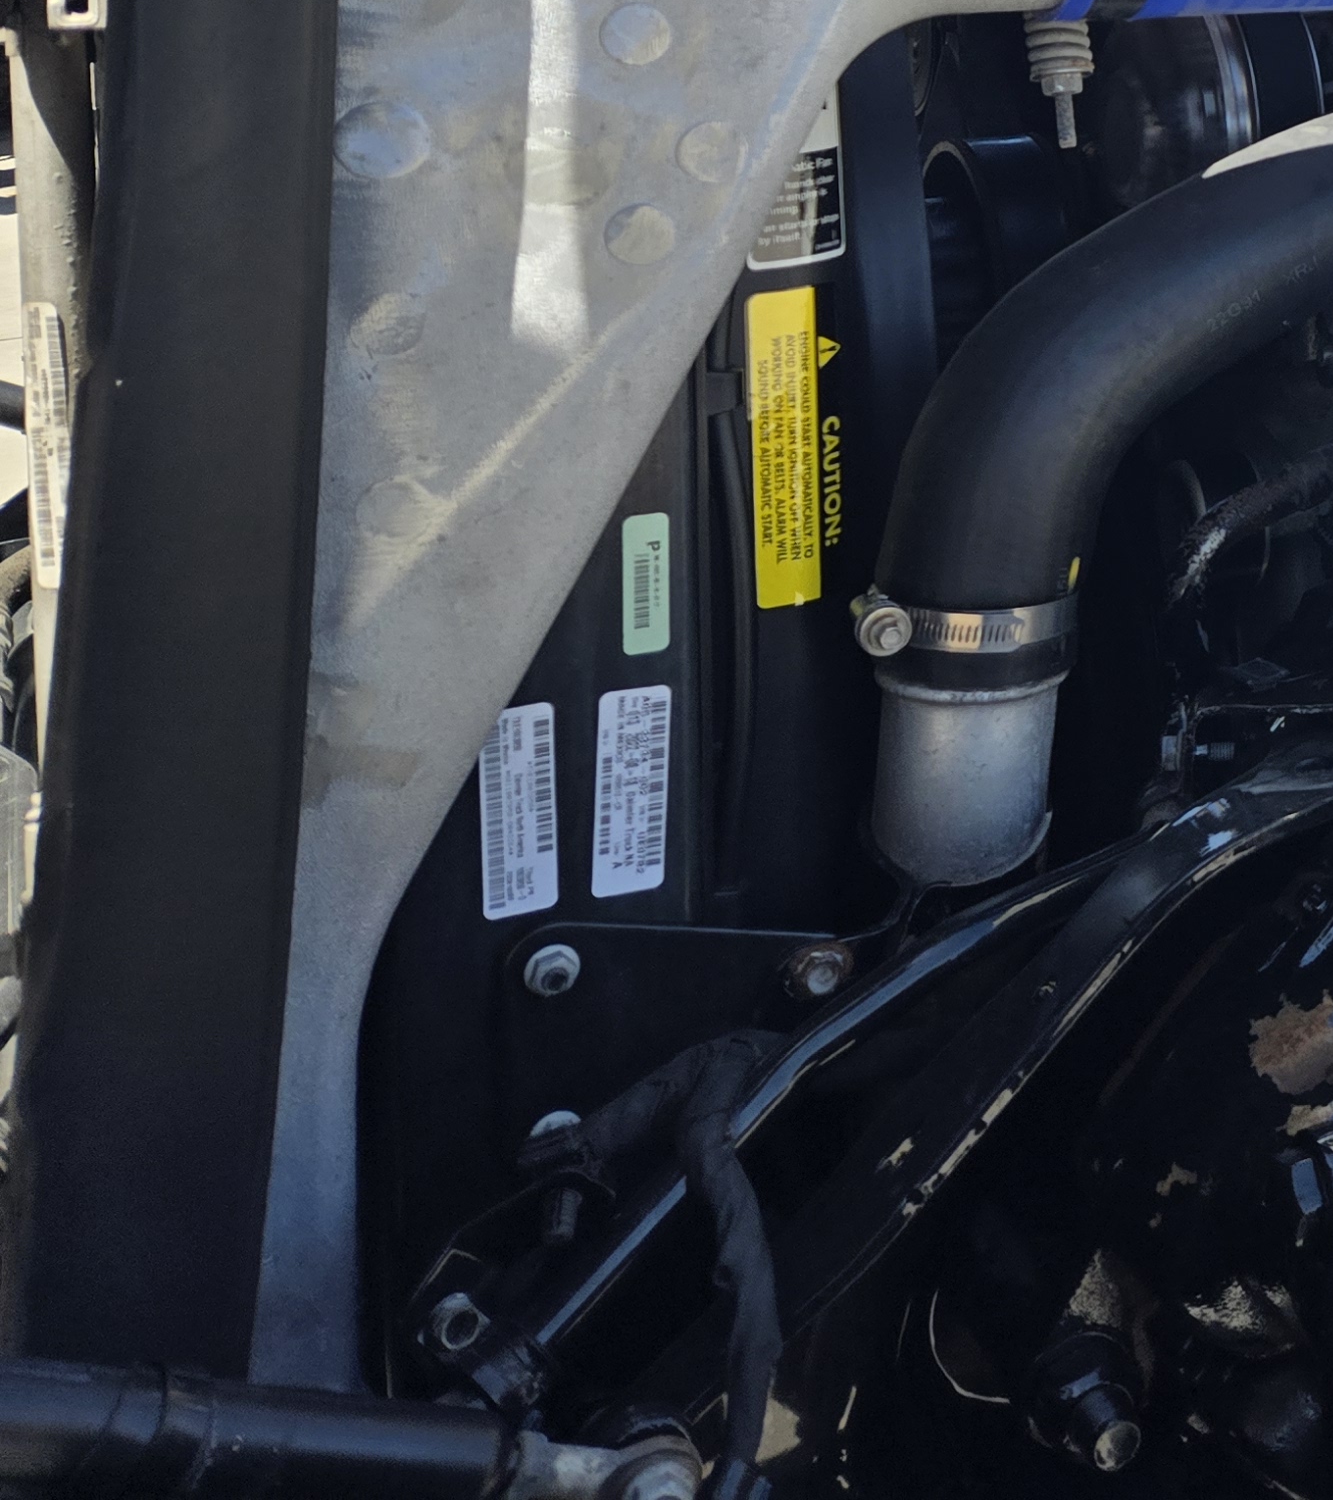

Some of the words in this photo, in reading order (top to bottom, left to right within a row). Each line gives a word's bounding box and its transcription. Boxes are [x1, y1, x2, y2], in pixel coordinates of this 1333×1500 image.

[773, 395, 783, 413] ON
[760, 447, 772, 511] AUTOMATIC
[821, 415, 841, 546] CAUTION:
[775, 498, 786, 536] ALARM
[776, 539, 787, 564] WILL
[790, 527, 801, 561] WHEN
[804, 542, 814, 558] TO
